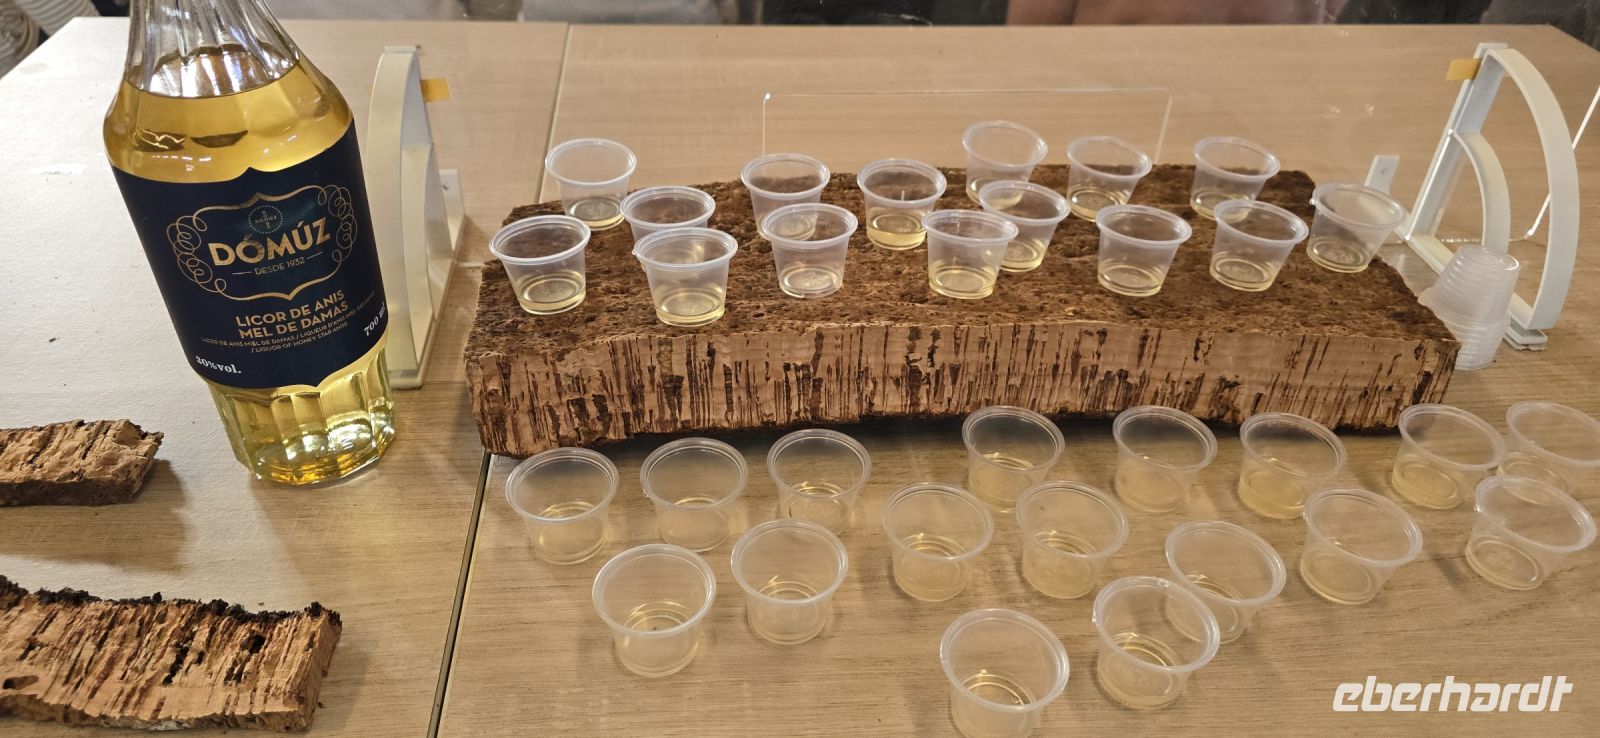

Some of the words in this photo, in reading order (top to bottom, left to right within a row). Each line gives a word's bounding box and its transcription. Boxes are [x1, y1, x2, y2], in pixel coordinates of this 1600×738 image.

[208, 217, 330, 266] DÓMÚZ
[254, 261, 284, 275] DESDE
[287, 256, 305, 268] 1932
[235, 311, 286, 327] LICOR
[290, 304, 311, 319] DE
[315, 289, 345, 312] ANIS
[238, 326, 273, 339] MEL
[276, 321, 298, 335] DE
[301, 300, 349, 329] DAMAS
[363, 316, 379, 336] 700
[255, 344, 281, 353] LIQUOR
[294, 336, 315, 346] HONEY
[271, 335, 295, 344] DAMAS
[300, 325, 327, 338] LIQUEUR
